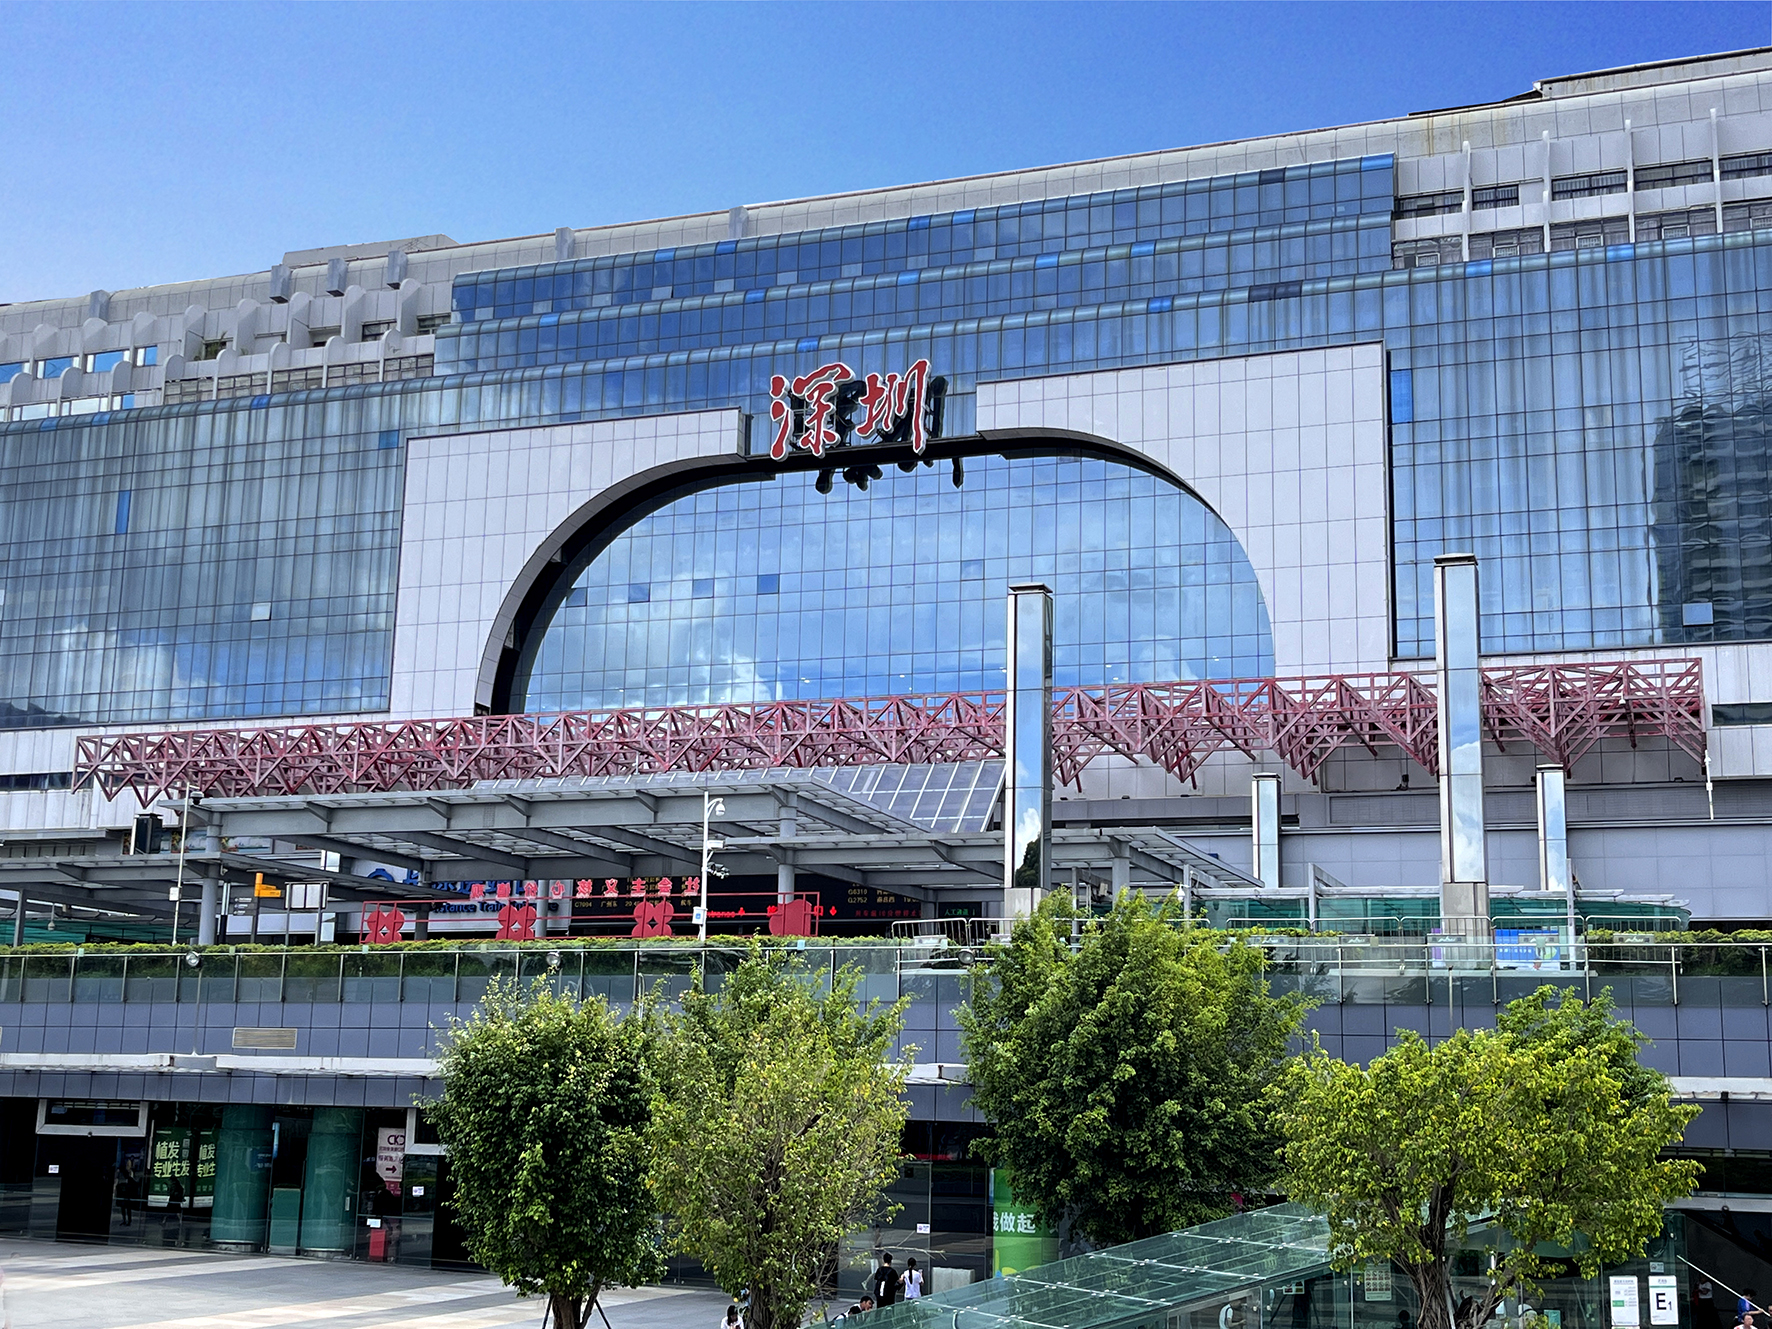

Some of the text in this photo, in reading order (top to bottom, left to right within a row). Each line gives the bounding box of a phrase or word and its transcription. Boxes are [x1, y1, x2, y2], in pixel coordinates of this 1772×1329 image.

[770, 358, 931, 461] 深圳
[155, 1140, 181, 1160] 植发
[199, 1143, 216, 1161] 植发
[153, 1160, 191, 1178] 专业生发
